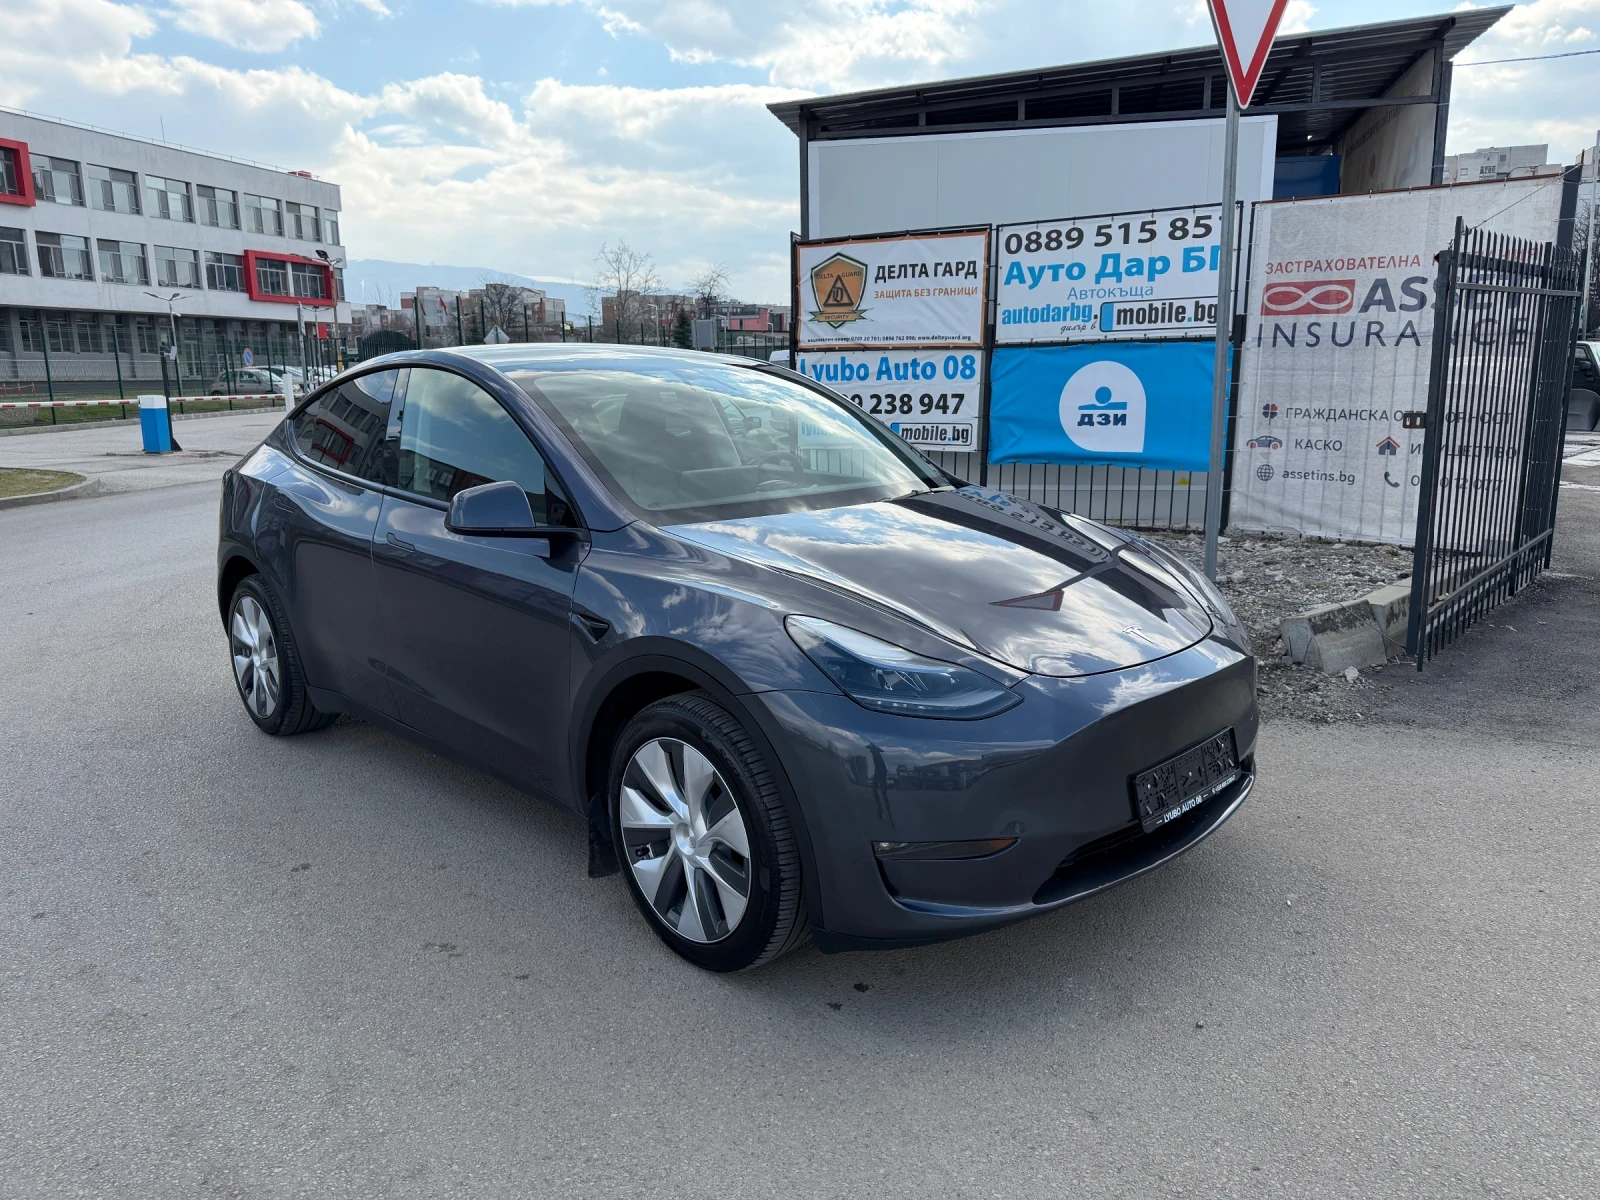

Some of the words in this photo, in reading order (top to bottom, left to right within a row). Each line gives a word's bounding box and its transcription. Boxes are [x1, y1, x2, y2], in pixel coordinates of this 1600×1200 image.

[1004, 226, 1084, 255] 0889
[1093, 220, 1157, 247] 515
[1168, 214, 1222, 241] 85
[874, 262, 929, 283] ДЕЛТА
[934, 260, 978, 280] ГАРД
[1003, 260, 1087, 290] Ауто
[1094, 252, 1171, 284] Дар
[1265, 254, 1421, 275] ЗАСТРАХОВАТЕЛНА
[841, 270, 862, 278] GUARD
[874, 289, 912, 300] ЗАЩИТА
[914, 288, 931, 297] БЕЗ
[933, 286, 978, 298] ГРАНИЦИ
[1066, 285, 1154, 301] Автокъща
[1116, 300, 1218, 326] mobile.bg
[918, 334, 971, 342] www.deltaguard.org
[800, 356, 870, 382] Lyubo
[876, 356, 937, 381] Auto
[943, 355, 976, 380] 08
[869, 393, 913, 415] 238
[919, 393, 965, 415] 947
[1077, 413, 1127, 426] ДЗИ
[1285, 407, 1389, 423] ГРАЖДАНСКА
[900, 426, 970, 443] mobile.bg
[1294, 438, 1343, 452] КАСКО
[1282, 469, 1356, 485] assetins.bg
[1163, 807, 1181, 823] LYUBO
[1181, 799, 1196, 813] AUTO
